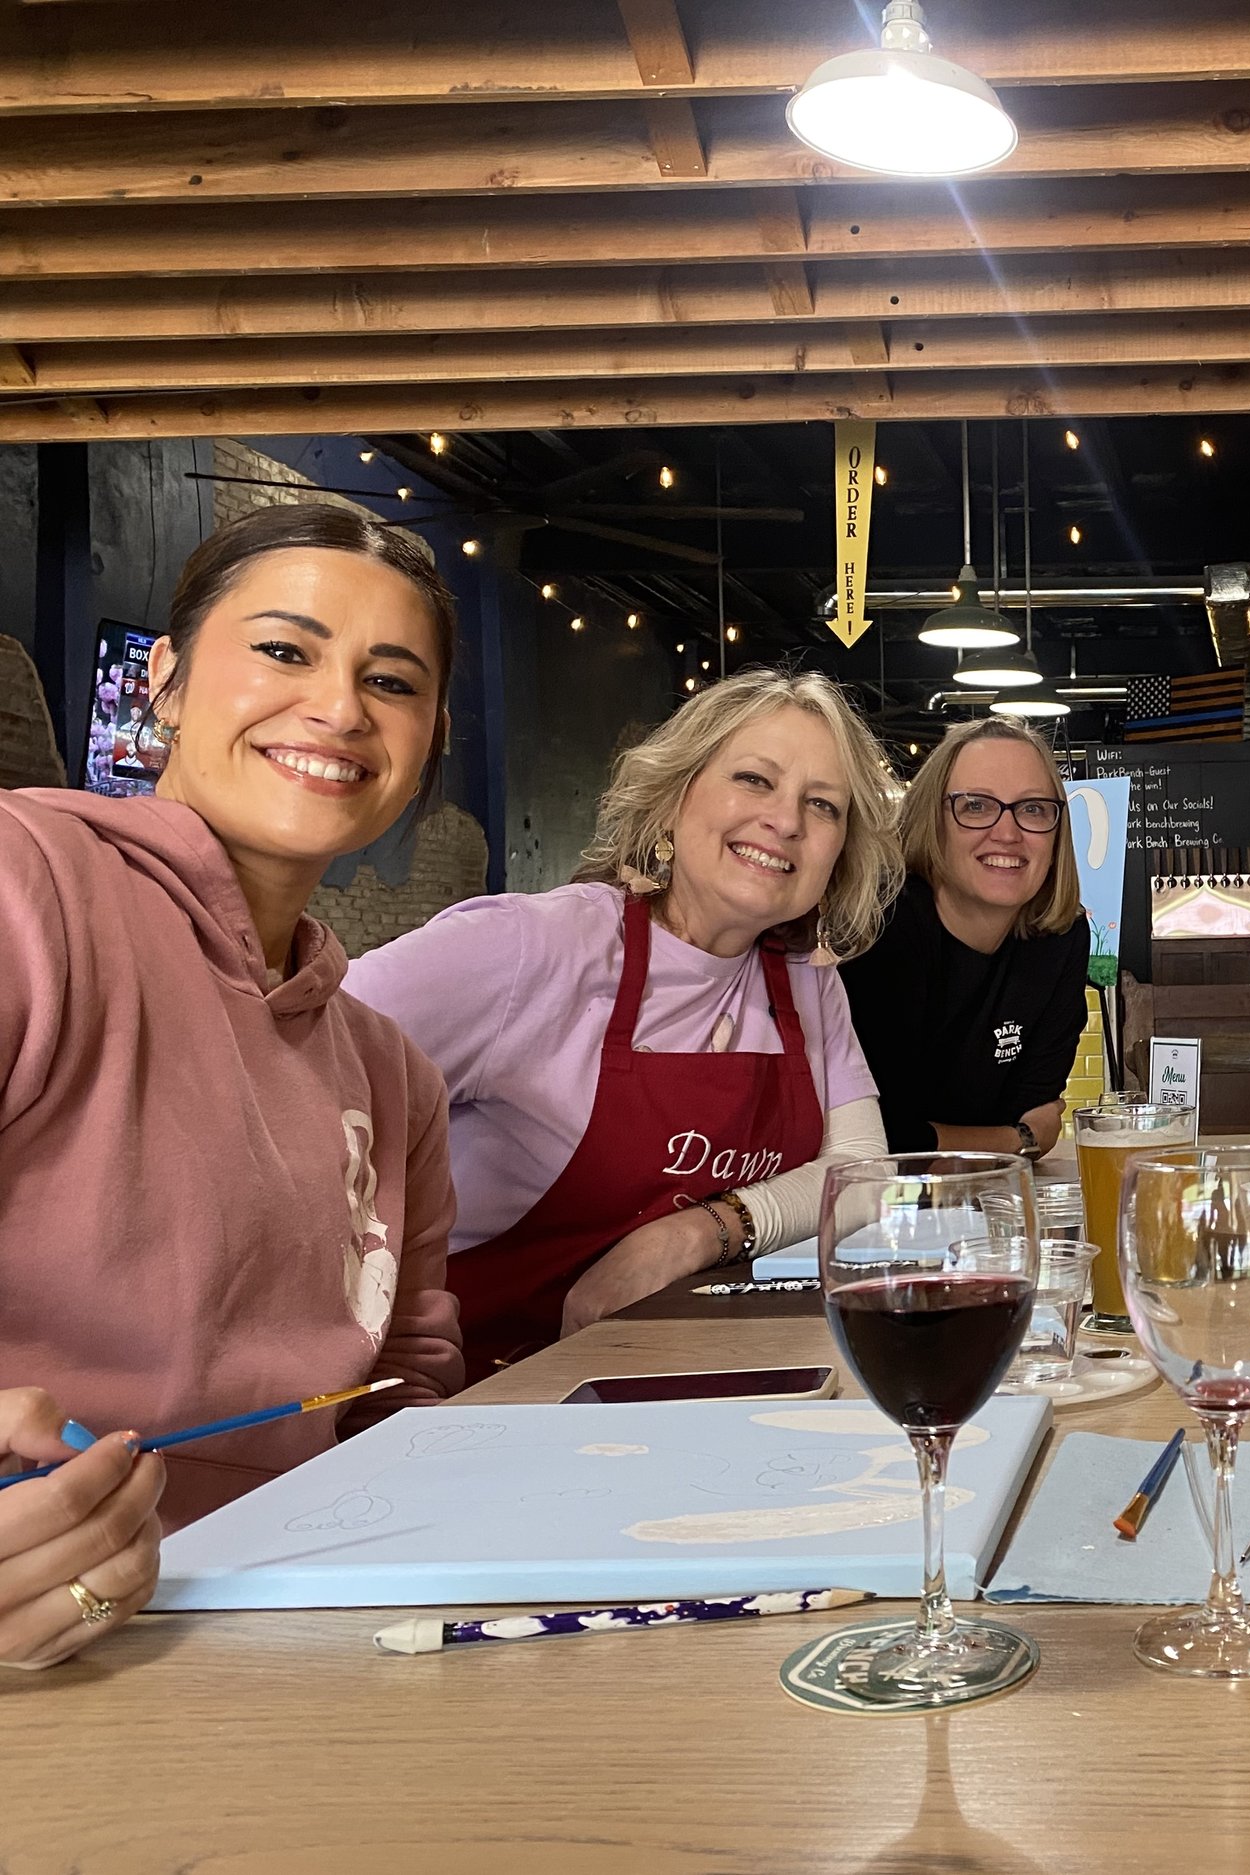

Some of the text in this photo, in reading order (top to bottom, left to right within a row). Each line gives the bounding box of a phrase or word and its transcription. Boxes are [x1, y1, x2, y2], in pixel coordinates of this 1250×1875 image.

[847, 446, 862, 538] ORDER
[129, 647, 149, 662] BOX
[1145, 778, 1162, 790] win!
[1147, 802, 1159, 812] on
[1163, 799, 1179, 811] Our
[1182, 796, 1214, 811] Socials!
[1146, 835, 1168, 849] Bench
[1174, 834, 1209, 849] Brewing
[993, 1024, 1024, 1039] PARK
[993, 1043, 1023, 1058] BENCH
[1161, 1066, 1186, 1085] Menu
[662, 1129, 783, 1183] Dawn
